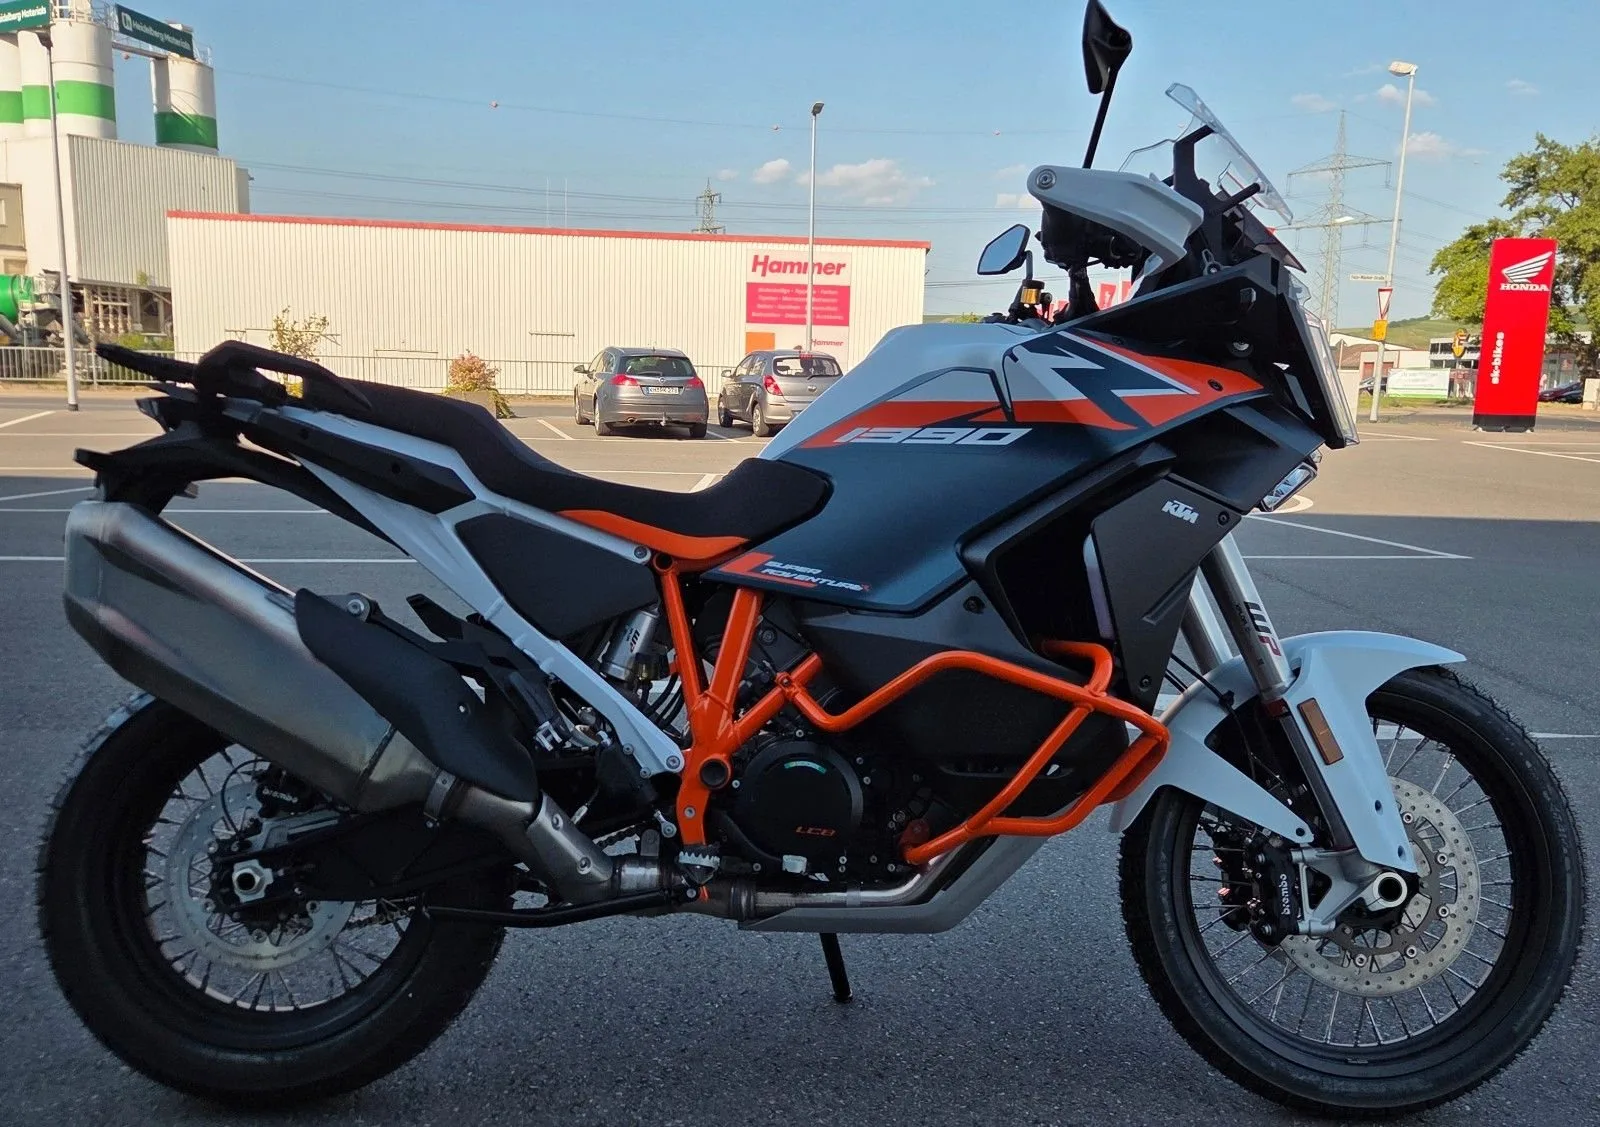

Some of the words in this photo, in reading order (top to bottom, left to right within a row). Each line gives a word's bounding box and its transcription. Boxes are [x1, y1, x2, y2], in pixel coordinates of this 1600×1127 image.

[752, 255, 846, 277] Hammer
[1500, 283, 1549, 292] HONDA
[810, 339, 844, 347] Hammer
[1490, 332, 1504, 384] sk-bikes
[833, 427, 1032, 445] 1390
[1161, 500, 1199, 524] KTM
[764, 561, 822, 574] SUPER
[760, 568, 863, 591] ADVENTURE
[1244, 601, 1281, 656] WP
[262, 786, 299, 803] brembo
[795, 826, 837, 837] LC8
[1278, 873, 1291, 915] brembo
